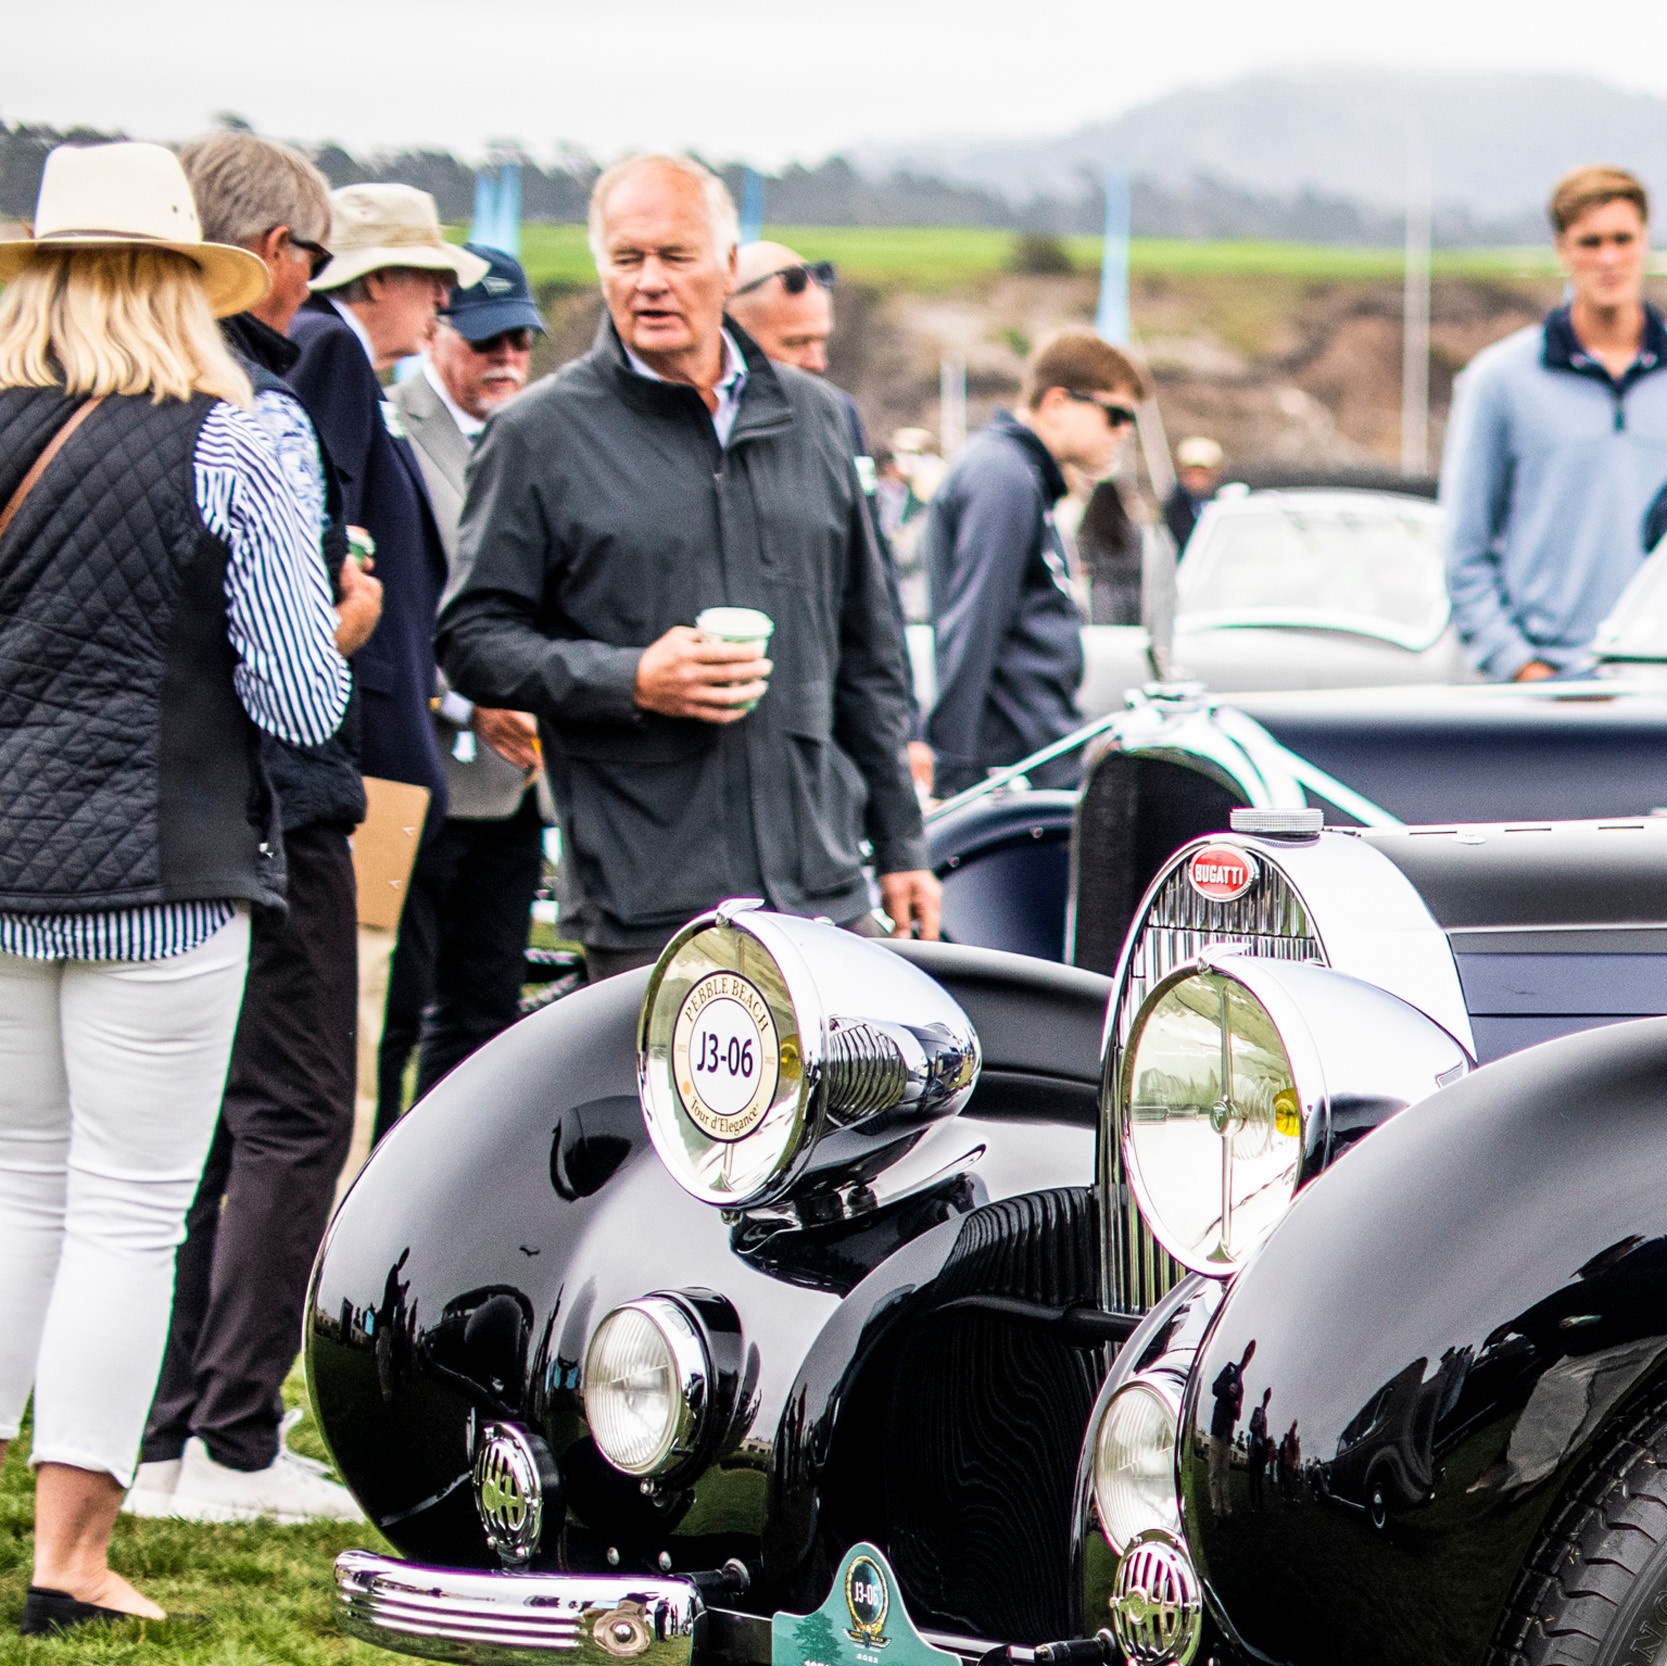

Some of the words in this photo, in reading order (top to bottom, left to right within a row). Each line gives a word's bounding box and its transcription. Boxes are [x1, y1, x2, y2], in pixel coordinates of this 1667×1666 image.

[1195, 864, 1243, 885] BUGATTI
[684, 977, 728, 1022] PEBBLE
[731, 978, 769, 1032] BEACH
[696, 1031, 753, 1078] J3-06
[690, 1096, 709, 1124] Tour
[854, 1581, 879, 1606] J3-06
